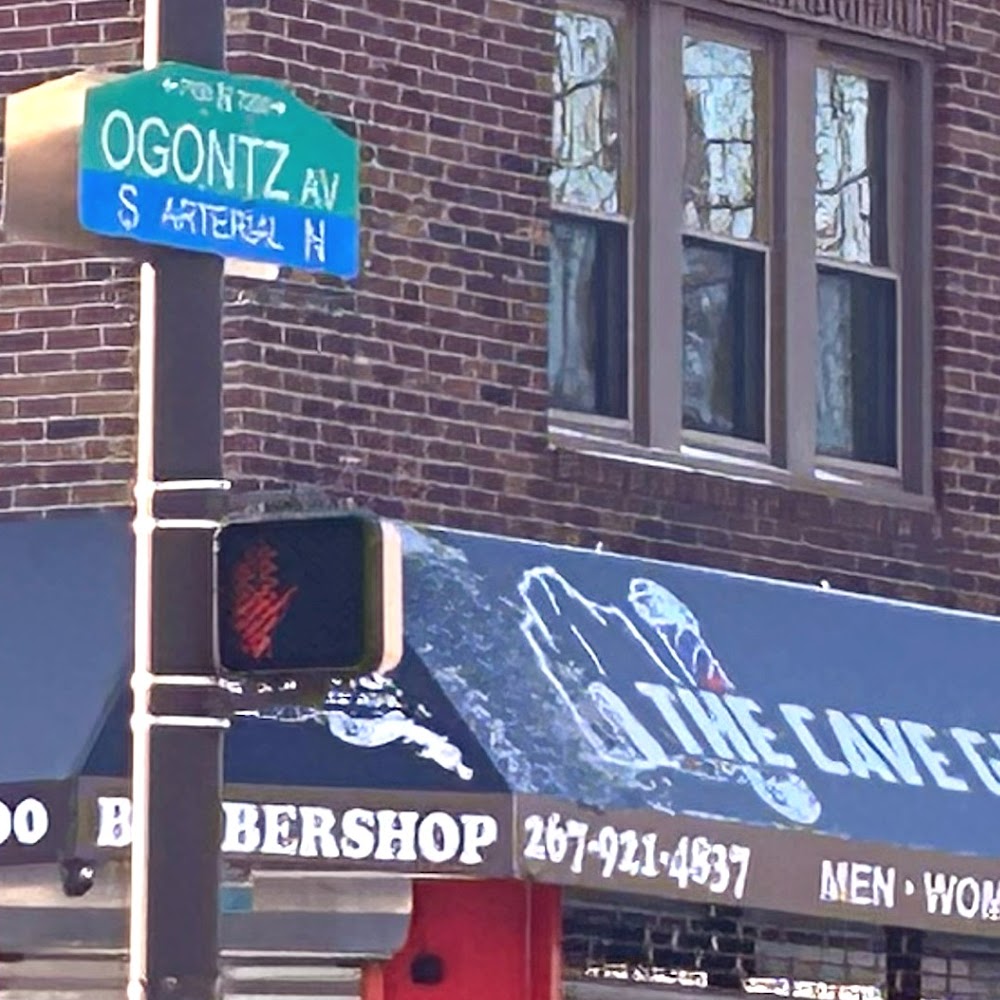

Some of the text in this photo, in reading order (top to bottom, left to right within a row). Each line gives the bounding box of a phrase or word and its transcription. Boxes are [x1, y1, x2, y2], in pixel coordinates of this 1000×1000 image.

[101, 109, 340, 211] OGONTZ AV
[117, 183, 140, 231] S
[304, 217, 326, 262] N
[635, 681, 797, 769] THE
[779, 703, 969, 792] CAVE
[97, 797, 497, 865] BBERSHOP
[820, 859, 896, 908] MEN
